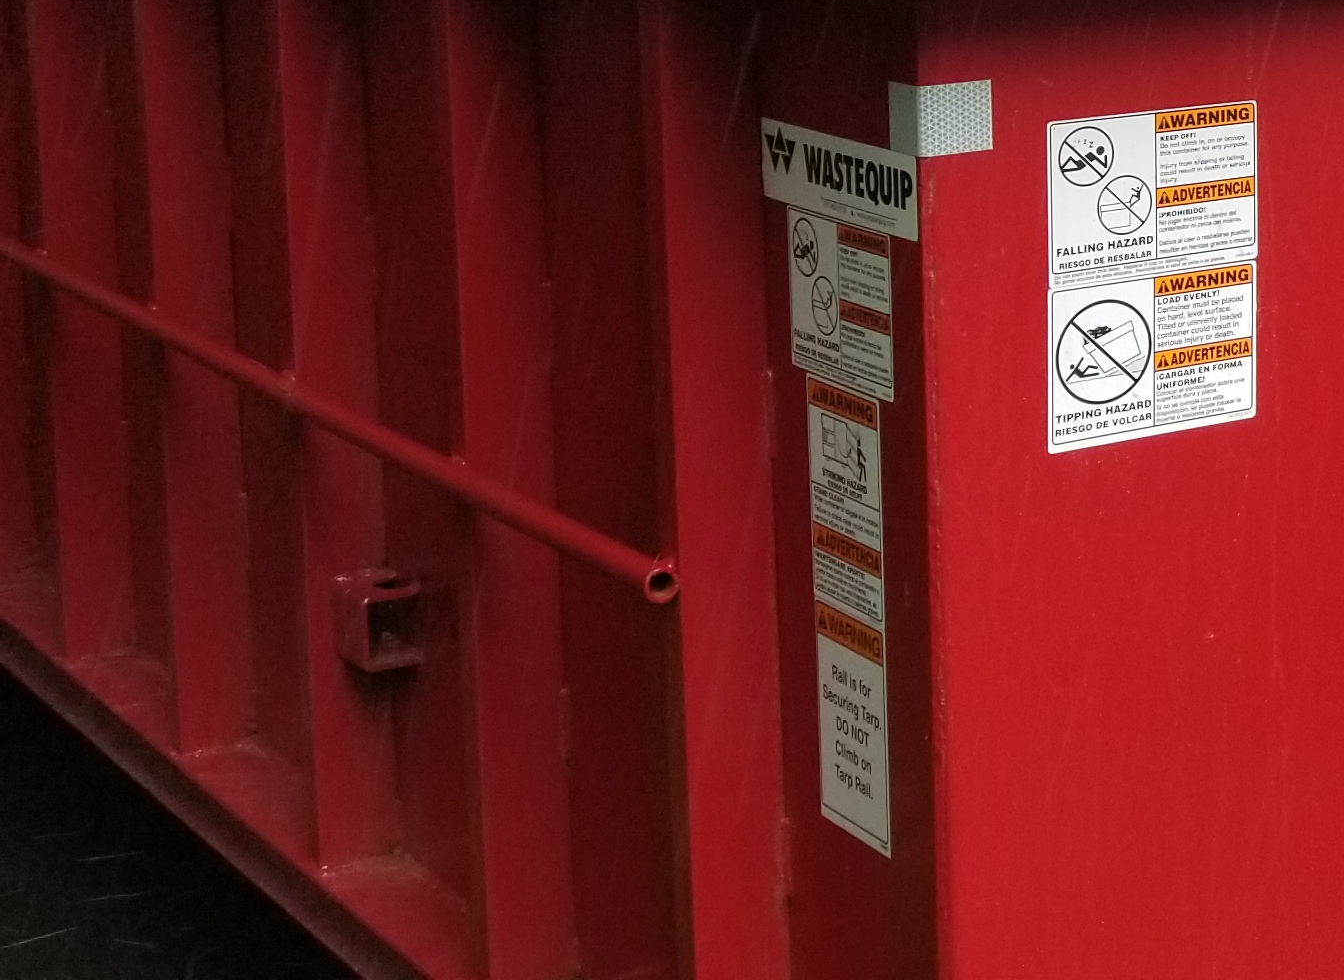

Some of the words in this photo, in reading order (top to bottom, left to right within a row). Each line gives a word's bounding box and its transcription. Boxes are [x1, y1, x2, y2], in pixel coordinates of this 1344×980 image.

[1170, 108, 1249, 128] WARNING
[803, 144, 912, 210] WASTEQUIP
[1173, 180, 1251, 202] ADVERTENCIA
[1057, 243, 1103, 257] FALLING
[1108, 236, 1154, 250] HAZARD
[1059, 259, 1091, 270] RIESGO
[1108, 251, 1152, 263] RESBALAR
[1170, 269, 1248, 291] WARNING
[1158, 296, 1180, 305] LOAD
[1184, 290, 1220, 301] EVENLY!
[1158, 304, 1190, 313] Container
[1222, 295, 1243, 305] placed
[794, 328, 816, 344] FALLING
[817, 337, 839, 352] HAZARD
[1157, 330, 1189, 339] container
[1191, 325, 1210, 333] could
[1212, 322, 1231, 330] result
[1158, 338, 1182, 348] serious
[1185, 334, 1204, 344] injury
[1171, 341, 1249, 365] ADVERTENCIA
[1213, 361, 1242, 371] FORMA
[1157, 376, 1205, 390] UNIFORME!
[819, 386, 873, 423] WARNING
[1055, 409, 1101, 424] TIPPING
[1106, 400, 1151, 415] HAZARD
[1055, 424, 1092, 437] RIESGO
[1096, 421, 1109, 429] DE
[1112, 413, 1152, 426] VOLCAR
[847, 479, 867, 494] HAZARD
[824, 530, 880, 572] ADVERTENCIA
[828, 613, 879, 656] WARNING
[832, 664, 847, 685] Rail
[860, 679, 871, 697] for
[823, 684, 858, 720] Securing
[861, 705, 881, 731] Tarp.
[836, 716, 848, 735] DO
[852, 725, 869, 748] NOT
[836, 740, 858, 766] Climb
[861, 759, 871, 774] on
[835, 763, 852, 789] Tarp
[856, 776, 873, 799] Rail.
